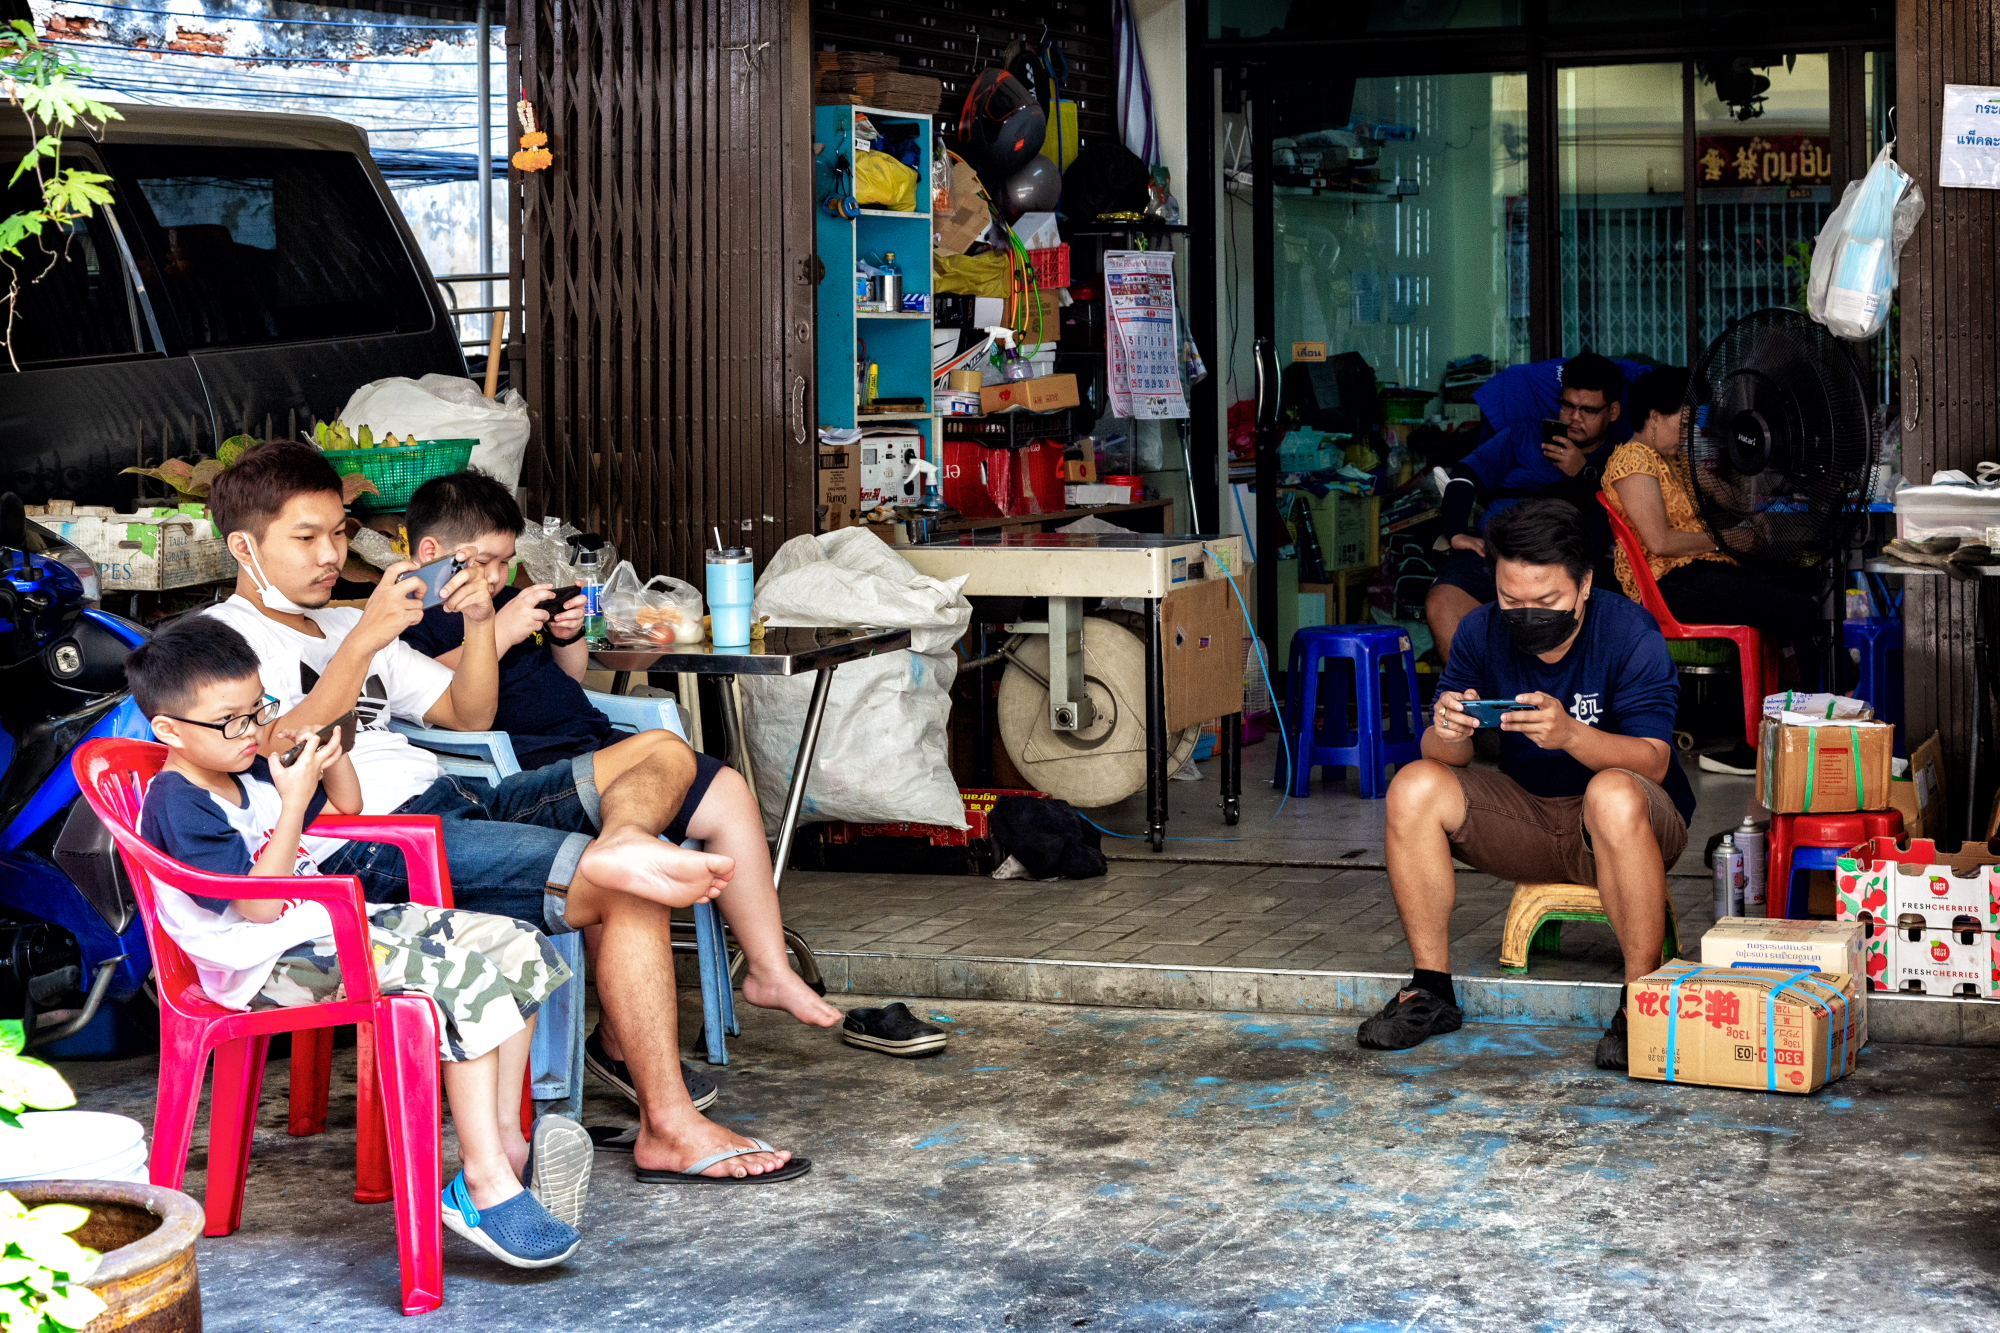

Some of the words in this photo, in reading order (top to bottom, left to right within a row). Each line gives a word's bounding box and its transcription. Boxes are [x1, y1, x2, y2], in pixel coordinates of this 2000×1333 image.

[1975, 104, 2000, 114] กระ
[1156, 323, 1160, 332] 2
[1129, 336, 1134, 345] 5
[1144, 336, 1148, 345] 7
[1143, 351, 1149, 360] 14
[1737, 432, 1756, 447] Hatari
[826, 492, 847, 504] Downy
[168, 536, 188, 547] TABLE
[165, 550, 191, 564] GRAPES
[1580, 698, 1603, 716] BTL
[1634, 989, 1740, 1029] 味ごのみ
[1725, 1026, 1750, 1040] 130g
[1761, 1027, 1801, 1038] アジゴノF
[1782, 1038, 1801, 1049] 130g
[1736, 1047, 1751, 1059] 03
